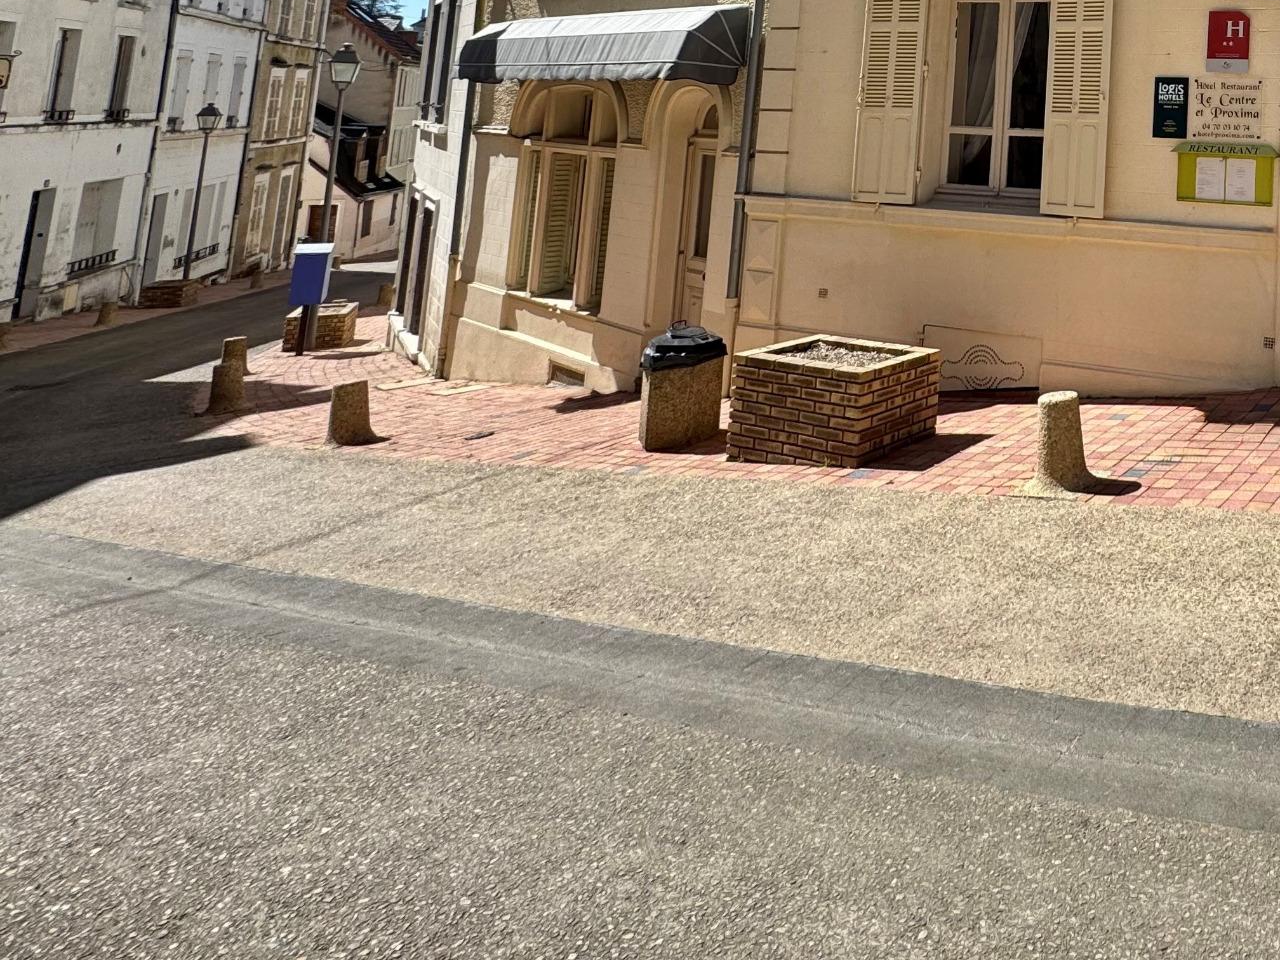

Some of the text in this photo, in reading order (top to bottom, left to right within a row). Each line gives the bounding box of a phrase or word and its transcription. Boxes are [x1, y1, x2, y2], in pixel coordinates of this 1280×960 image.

[1226, 20, 1244, 38] H
[1220, 82, 1260, 91] Restaurant
[1195, 93, 1257, 108] Le Centre
[1195, 106, 1259, 120] et Proxima
[1188, 144, 1259, 155] RESTAURANT
